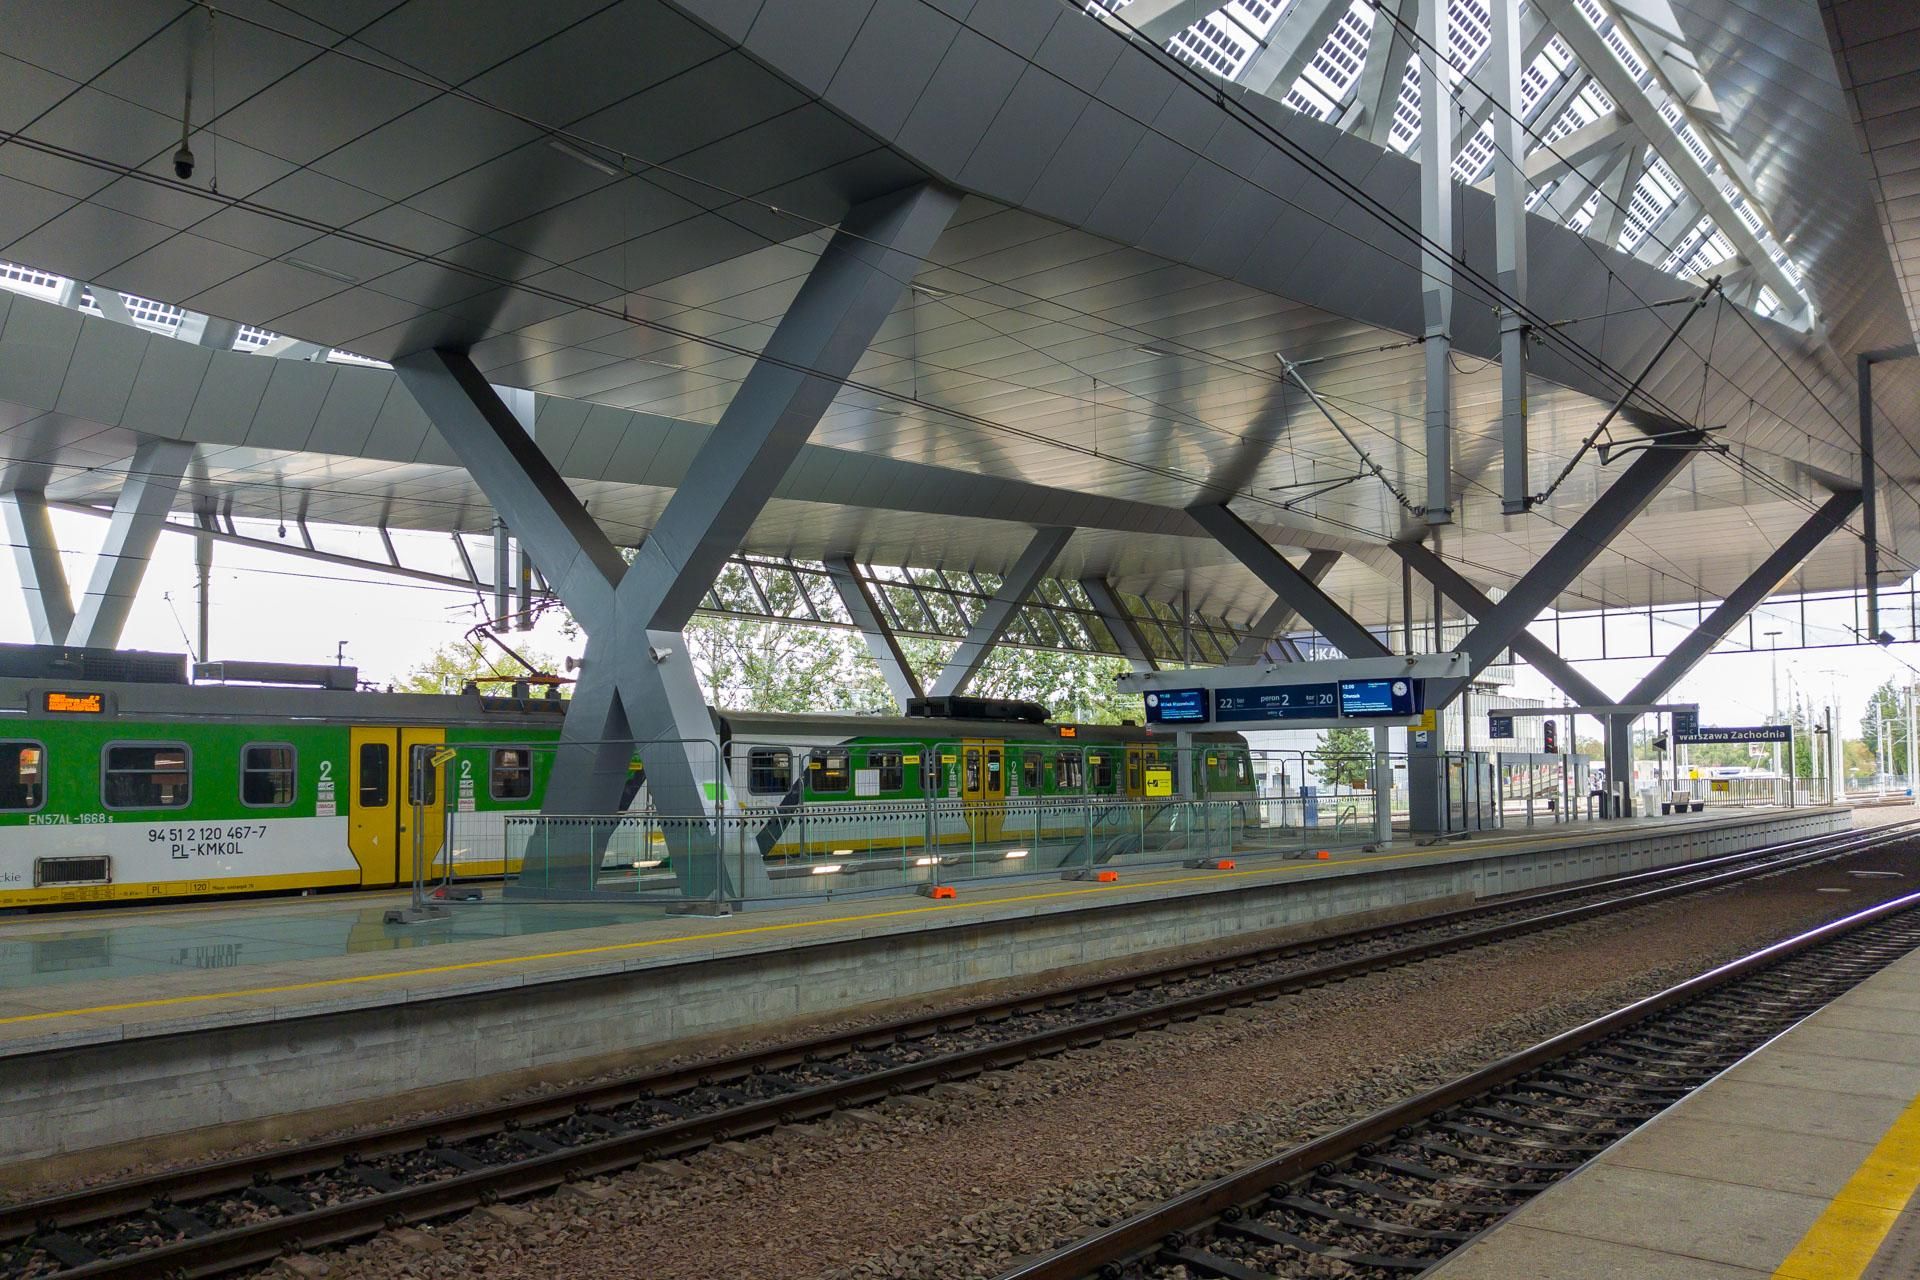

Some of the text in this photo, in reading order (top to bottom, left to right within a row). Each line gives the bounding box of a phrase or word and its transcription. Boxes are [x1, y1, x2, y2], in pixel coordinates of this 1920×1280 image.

[1309, 647, 1343, 660] SKA
[1220, 698, 1233, 708] 22
[1260, 694, 1290, 706] peron 2
[1320, 693, 1334, 704] 20
[1730, 730, 1786, 740] Zachodnia
[320, 760, 332, 781] 2
[461, 759, 472, 779] 2
[28, 813, 106, 825] EN57AL-1668
[148, 825, 267, 842] 94 51 2 120 467-7
[172, 842, 244, 858] PL-KMKOL
[152, 886, 163, 894] PL
[193, 883, 207, 892] 120
